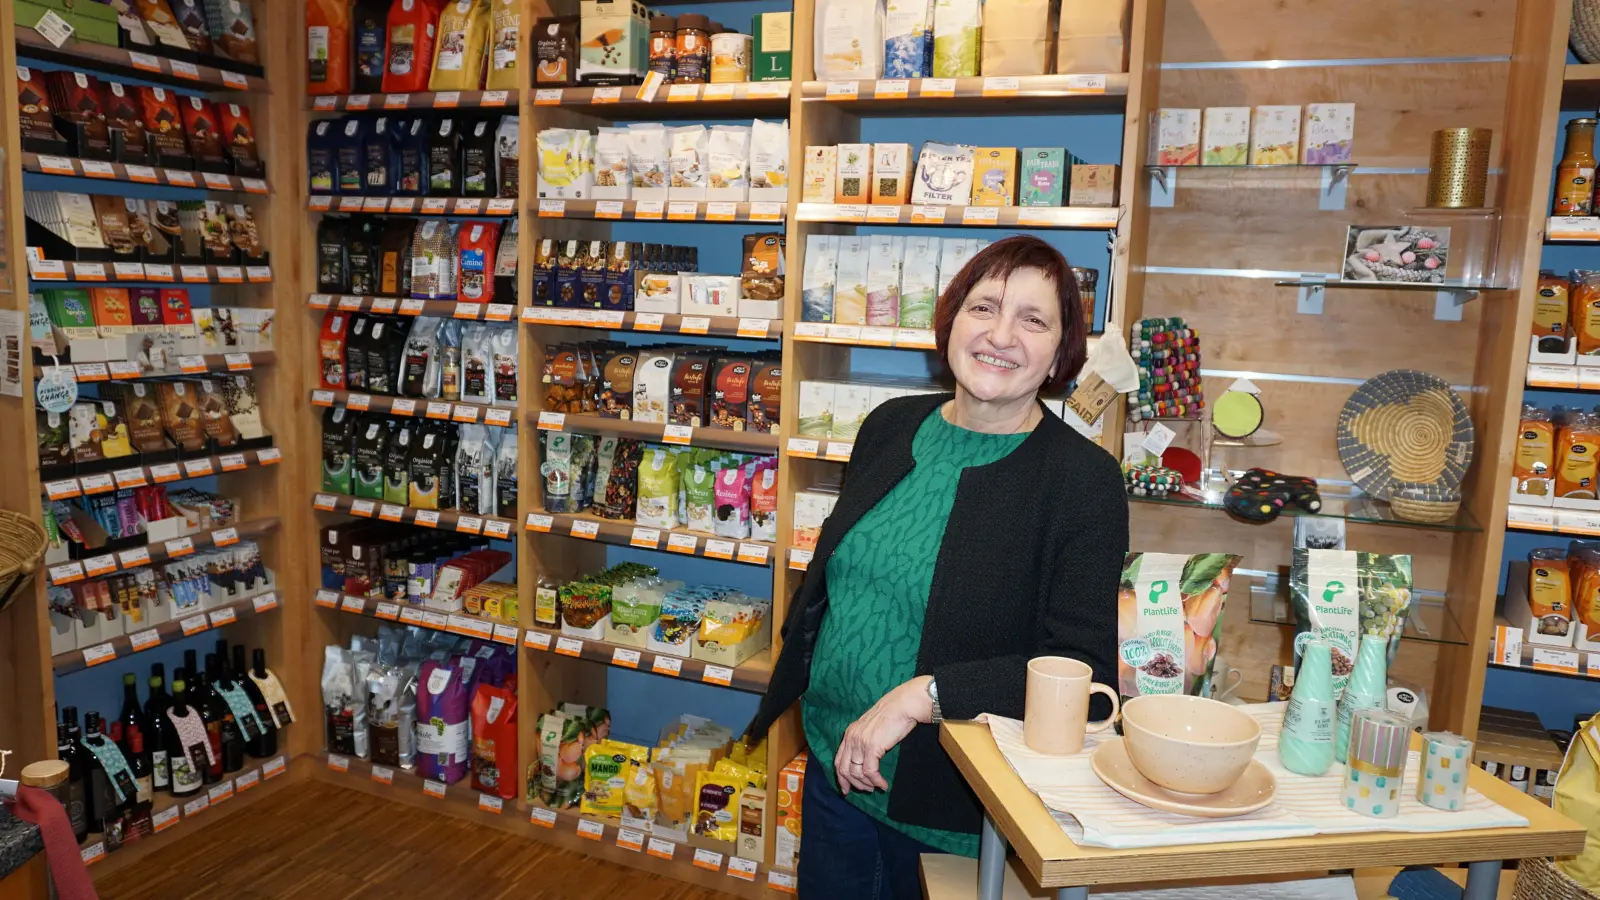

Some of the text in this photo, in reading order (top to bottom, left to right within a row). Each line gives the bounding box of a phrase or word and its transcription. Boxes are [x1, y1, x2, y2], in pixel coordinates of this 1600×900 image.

[771, 56, 782, 71] L
[924, 191, 952, 201] FILTER
[1067, 396, 1093, 424] FAIR
[715, 489, 737, 499] Rosinen
[1143, 606, 1178, 616] PlantLife
[1315, 605, 1353, 615] PlantLife
[1124, 645, 1148, 660] 100%
[591, 763, 618, 773] MANGO
